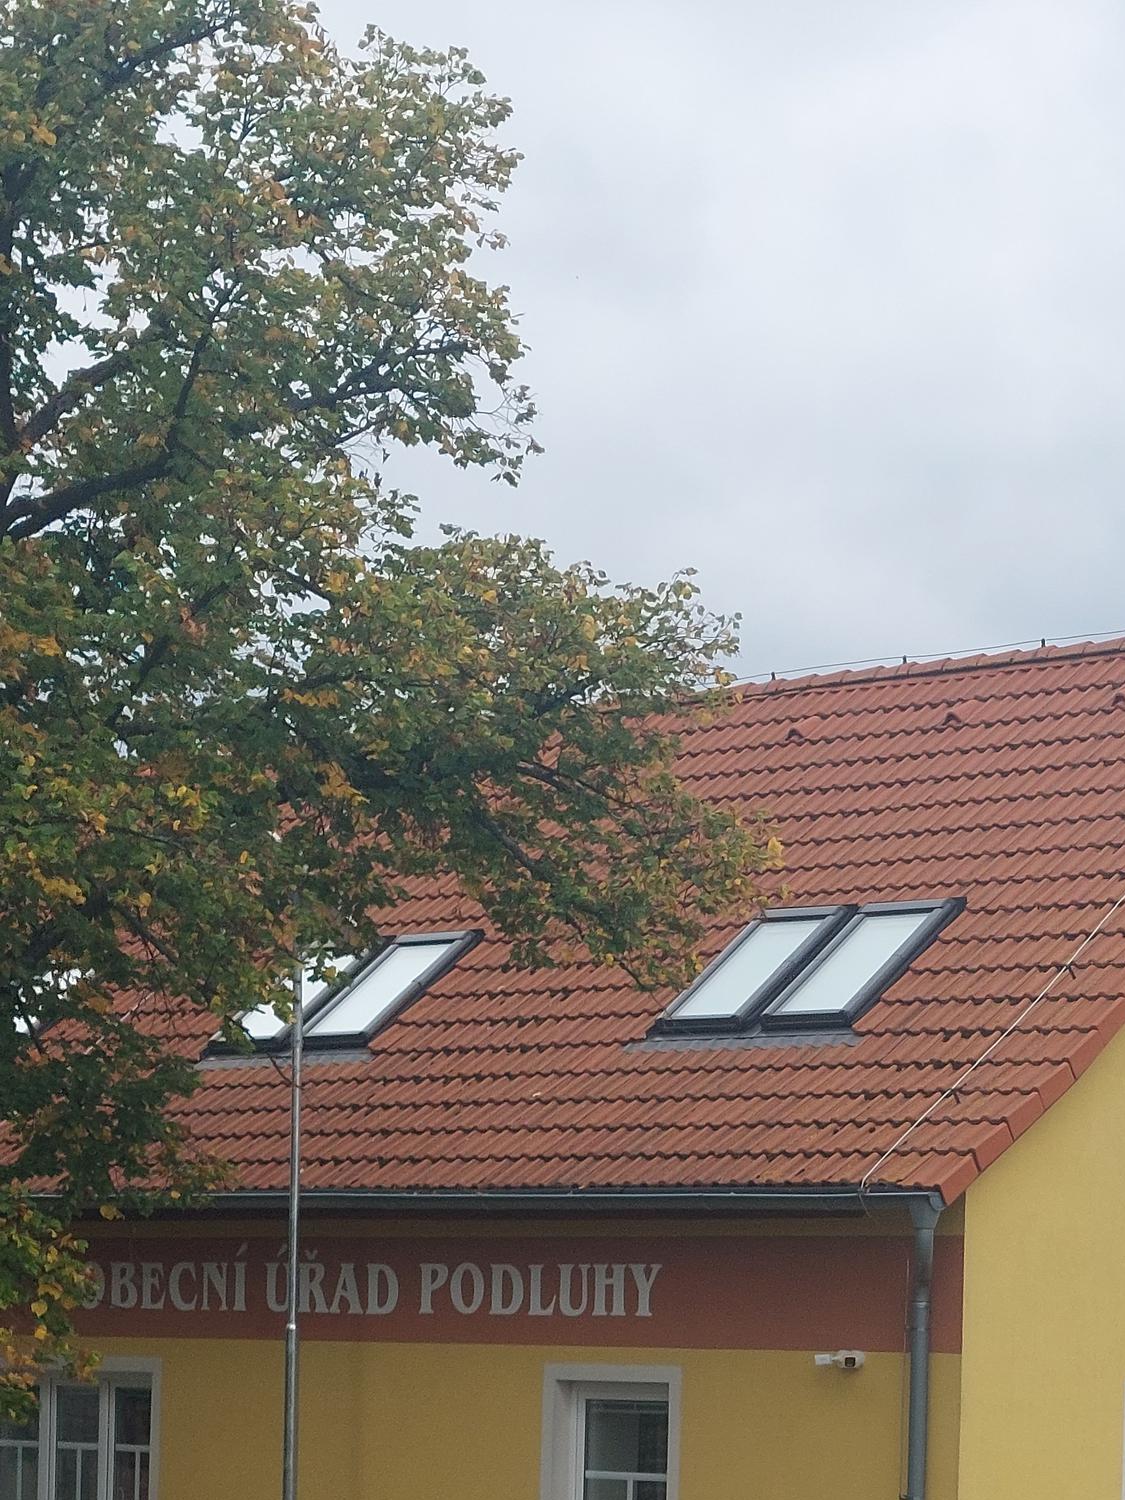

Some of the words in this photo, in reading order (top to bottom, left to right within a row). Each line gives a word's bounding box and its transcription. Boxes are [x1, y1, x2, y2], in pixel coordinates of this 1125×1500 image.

[80, 1242, 248, 1312] OBECNÍ
[265, 1243, 400, 1315] ÚŘAD
[418, 1262, 663, 1317] PODLUHY
